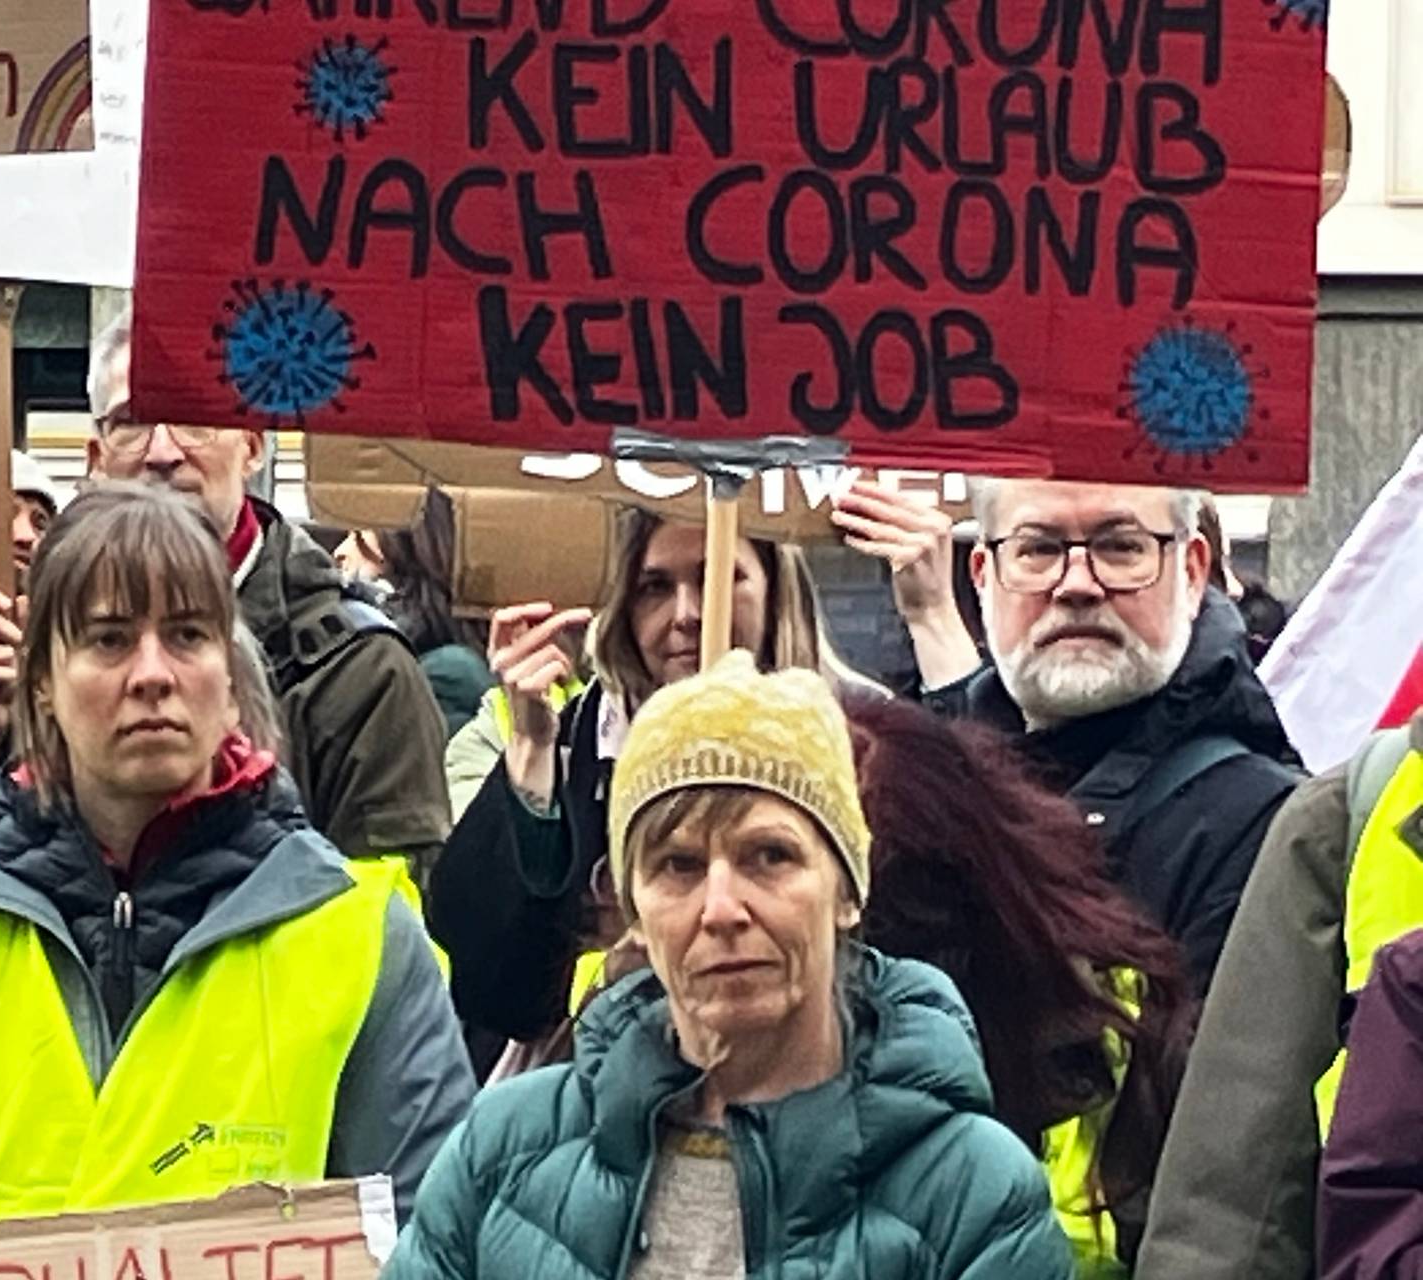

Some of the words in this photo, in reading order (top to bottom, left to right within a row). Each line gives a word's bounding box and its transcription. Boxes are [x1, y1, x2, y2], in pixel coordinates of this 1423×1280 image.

[468, 31, 732, 158] KEIN
[794, 57, 1226, 195] URLAUB
[254, 155, 612, 280] NACH
[685, 165, 1198, 310] CORONA
[477, 284, 748, 425] KEIN
[778, 301, 1019, 435] JOB
